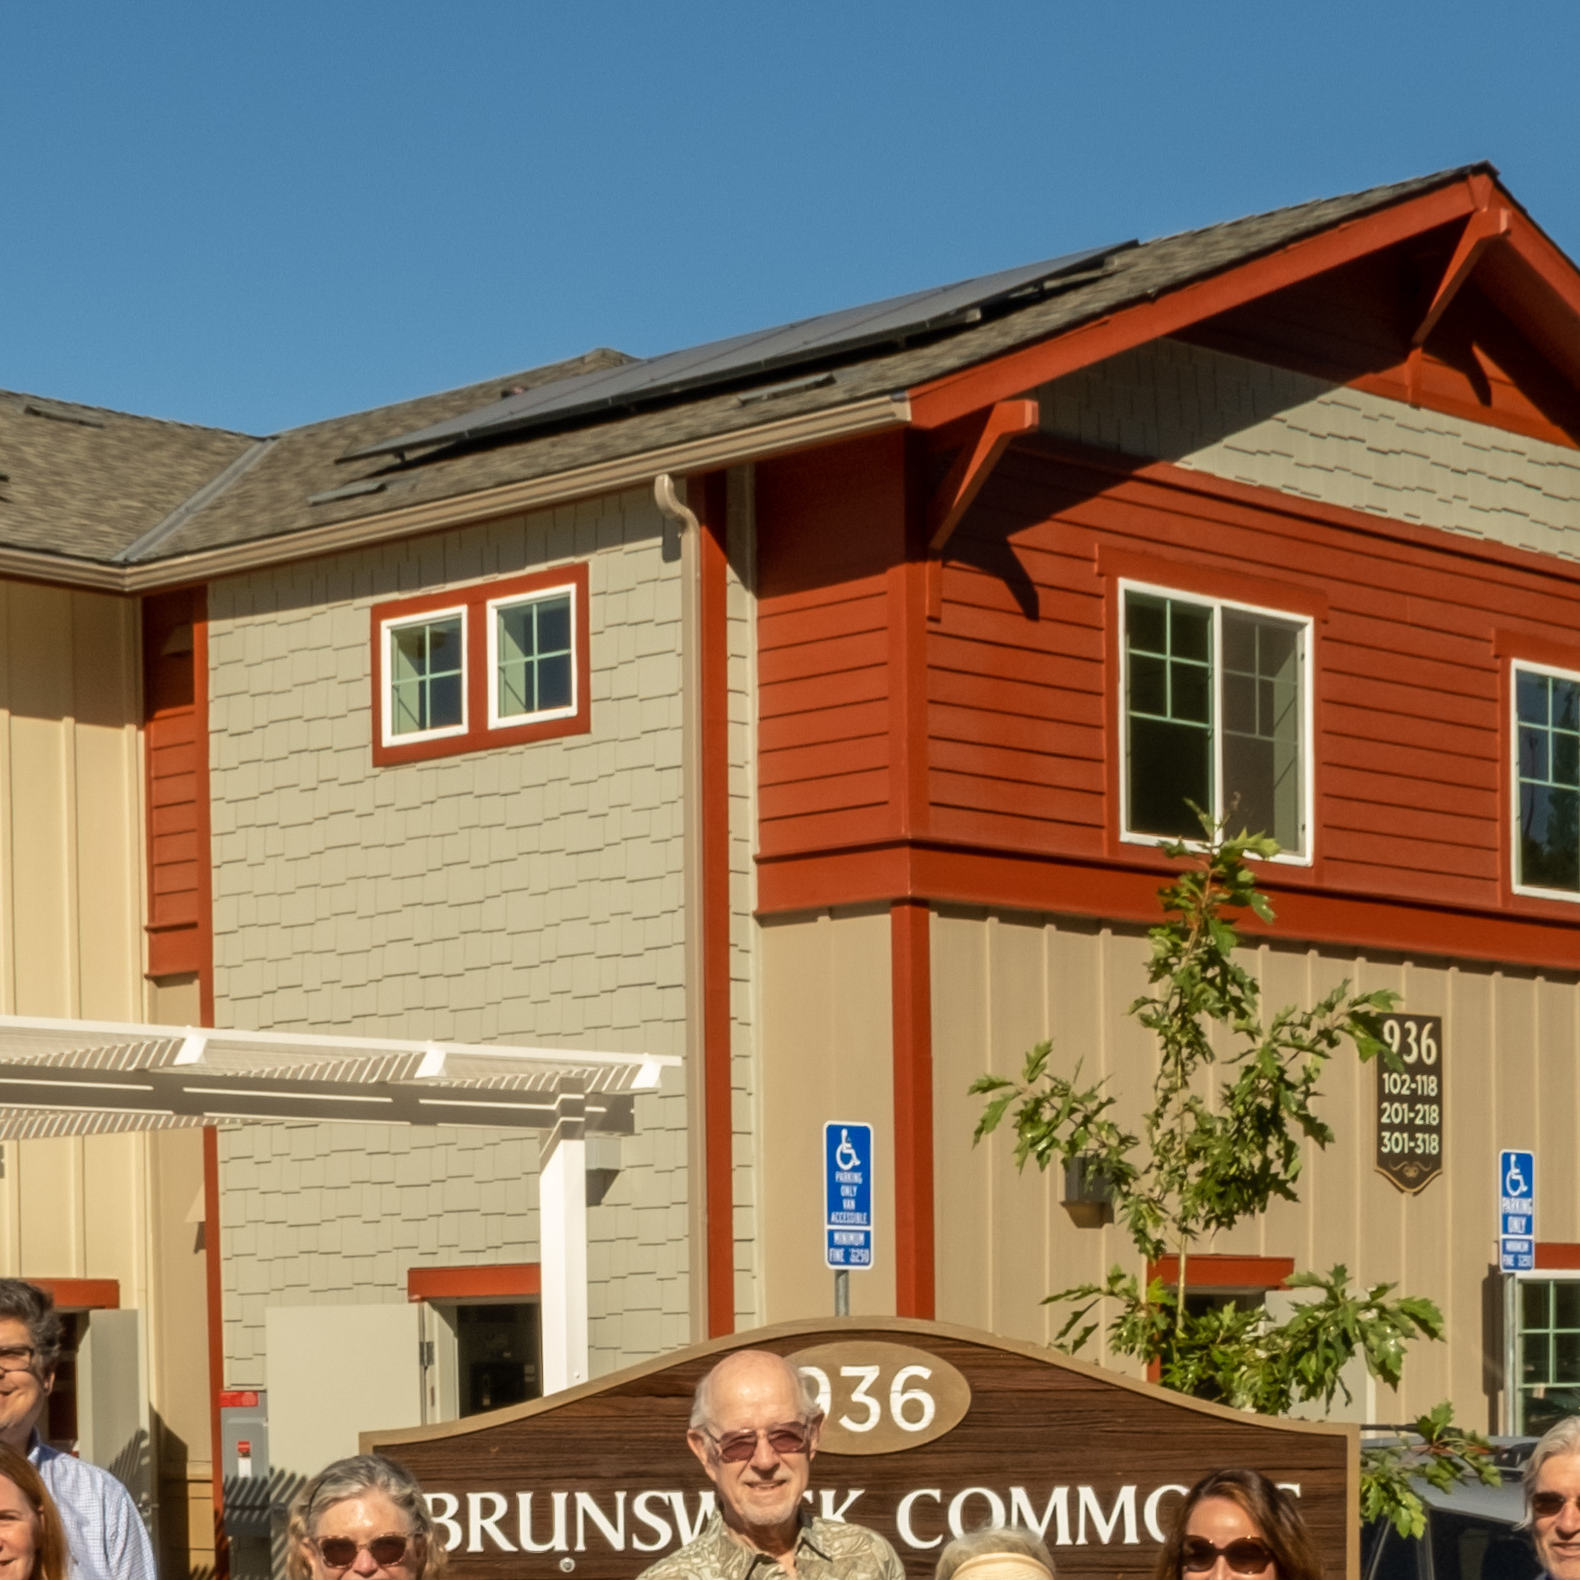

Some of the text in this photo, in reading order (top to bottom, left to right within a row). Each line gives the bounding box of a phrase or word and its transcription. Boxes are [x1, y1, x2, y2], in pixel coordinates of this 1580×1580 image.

[1382, 1019, 1438, 1066] 936
[1382, 1072, 1438, 1097] 102-118
[1380, 1102, 1440, 1126] 201-218
[1380, 1131, 1440, 1155] 301-318
[835, 1171, 863, 1184] PARKING
[840, 1185, 858, 1197] ONLY
[842, 1198, 856, 1210] VAN
[1502, 1197, 1533, 1215] PARKING
[830, 1211, 868, 1224] ACCESSIBLE
[833, 1232, 865, 1246] MINIMUM
[829, 1248, 845, 1262] FINE
[798, 1364, 936, 1433] 936
